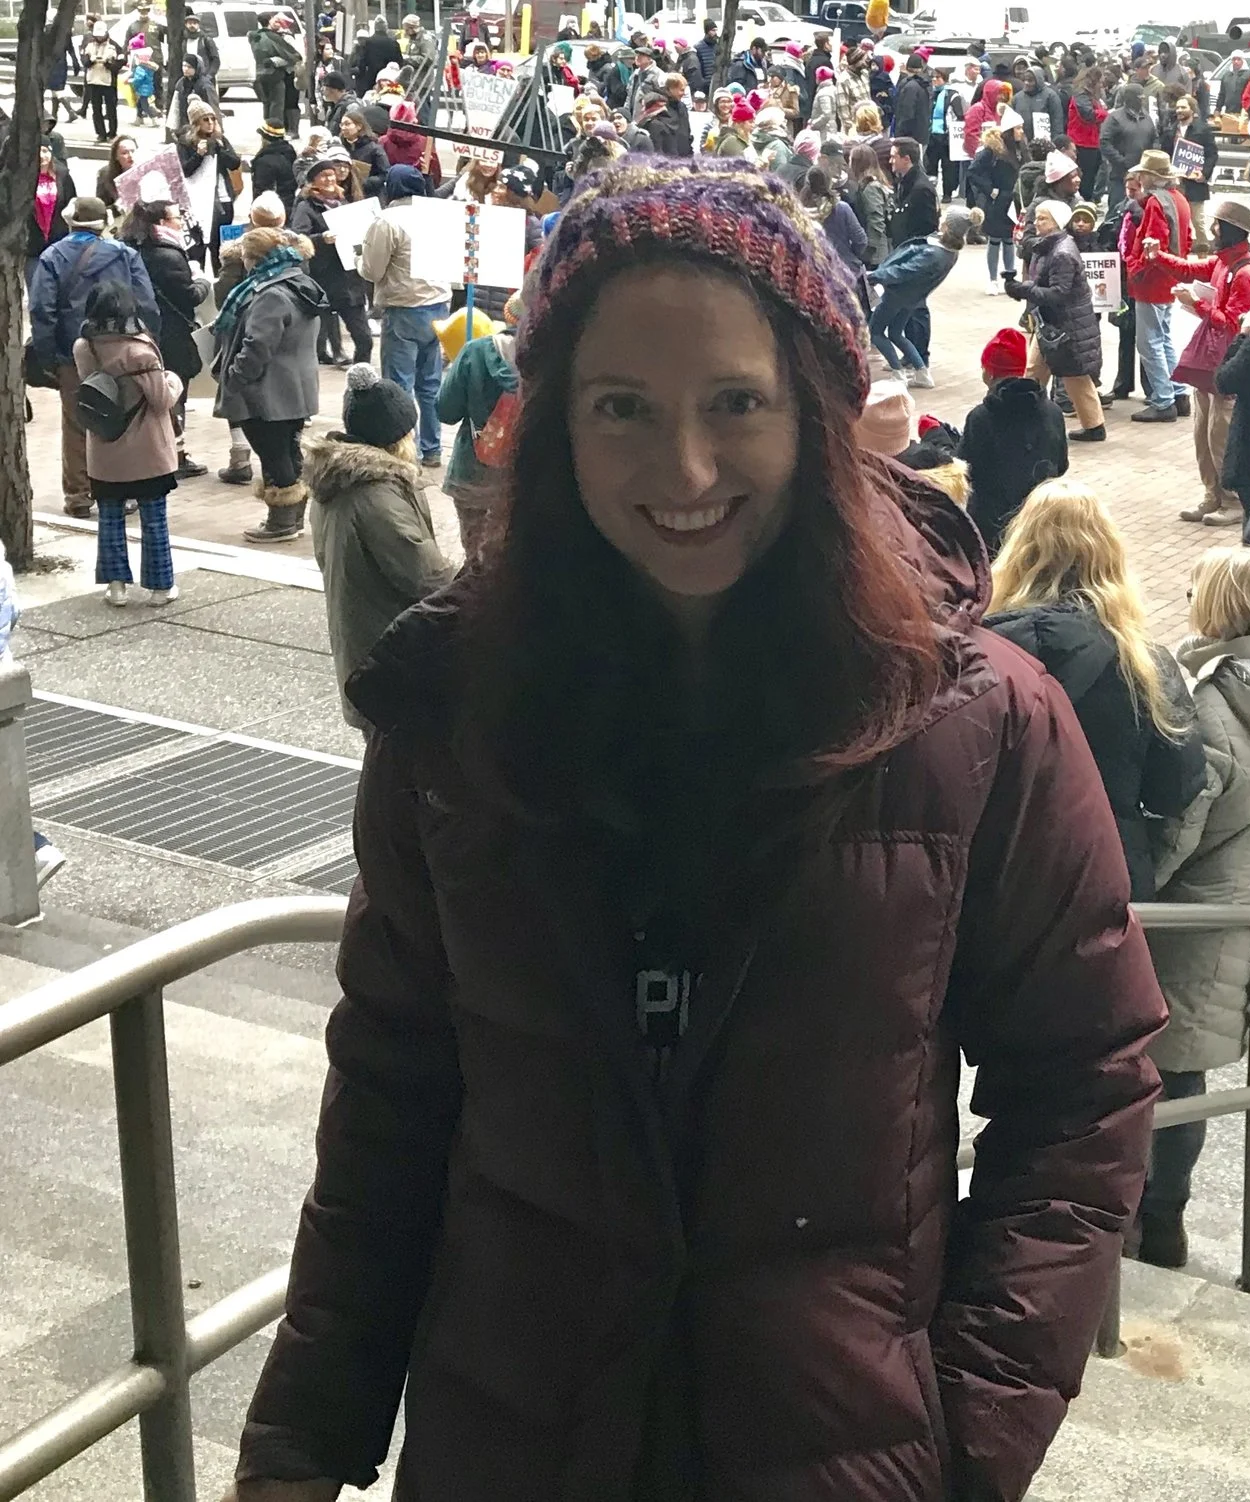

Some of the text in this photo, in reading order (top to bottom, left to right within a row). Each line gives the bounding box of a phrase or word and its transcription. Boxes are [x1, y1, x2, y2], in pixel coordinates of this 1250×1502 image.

[471, 126, 493, 136] NOT
[453, 143, 500, 161] WALLS
[1085, 270, 1105, 279] RISE
